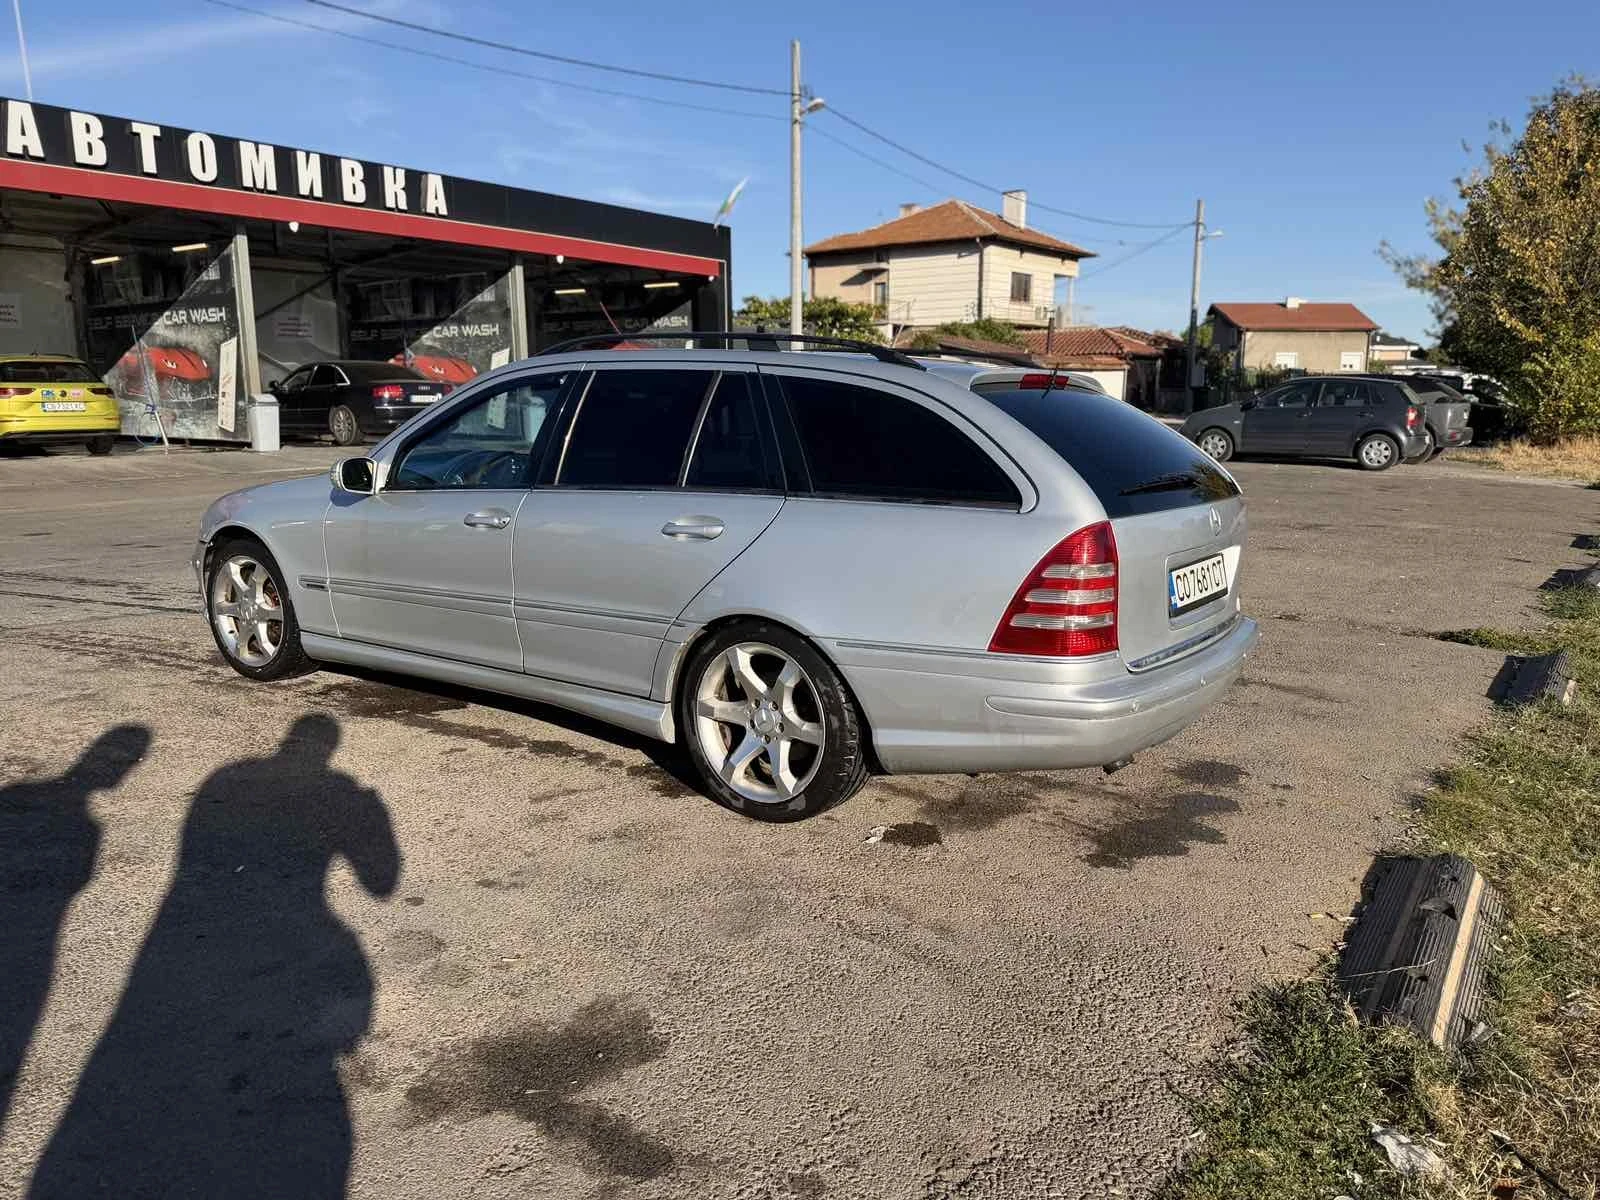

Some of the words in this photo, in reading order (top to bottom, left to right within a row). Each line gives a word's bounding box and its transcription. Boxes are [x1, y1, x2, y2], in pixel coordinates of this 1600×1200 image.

[6, 100, 448, 216] АВТОМИВКА
[163, 310, 187, 325] CAR
[188, 307, 226, 323] WASH
[652, 316, 688, 328] WASH
[433, 325, 458, 338] CAR
[461, 323, 500, 337] WASH
